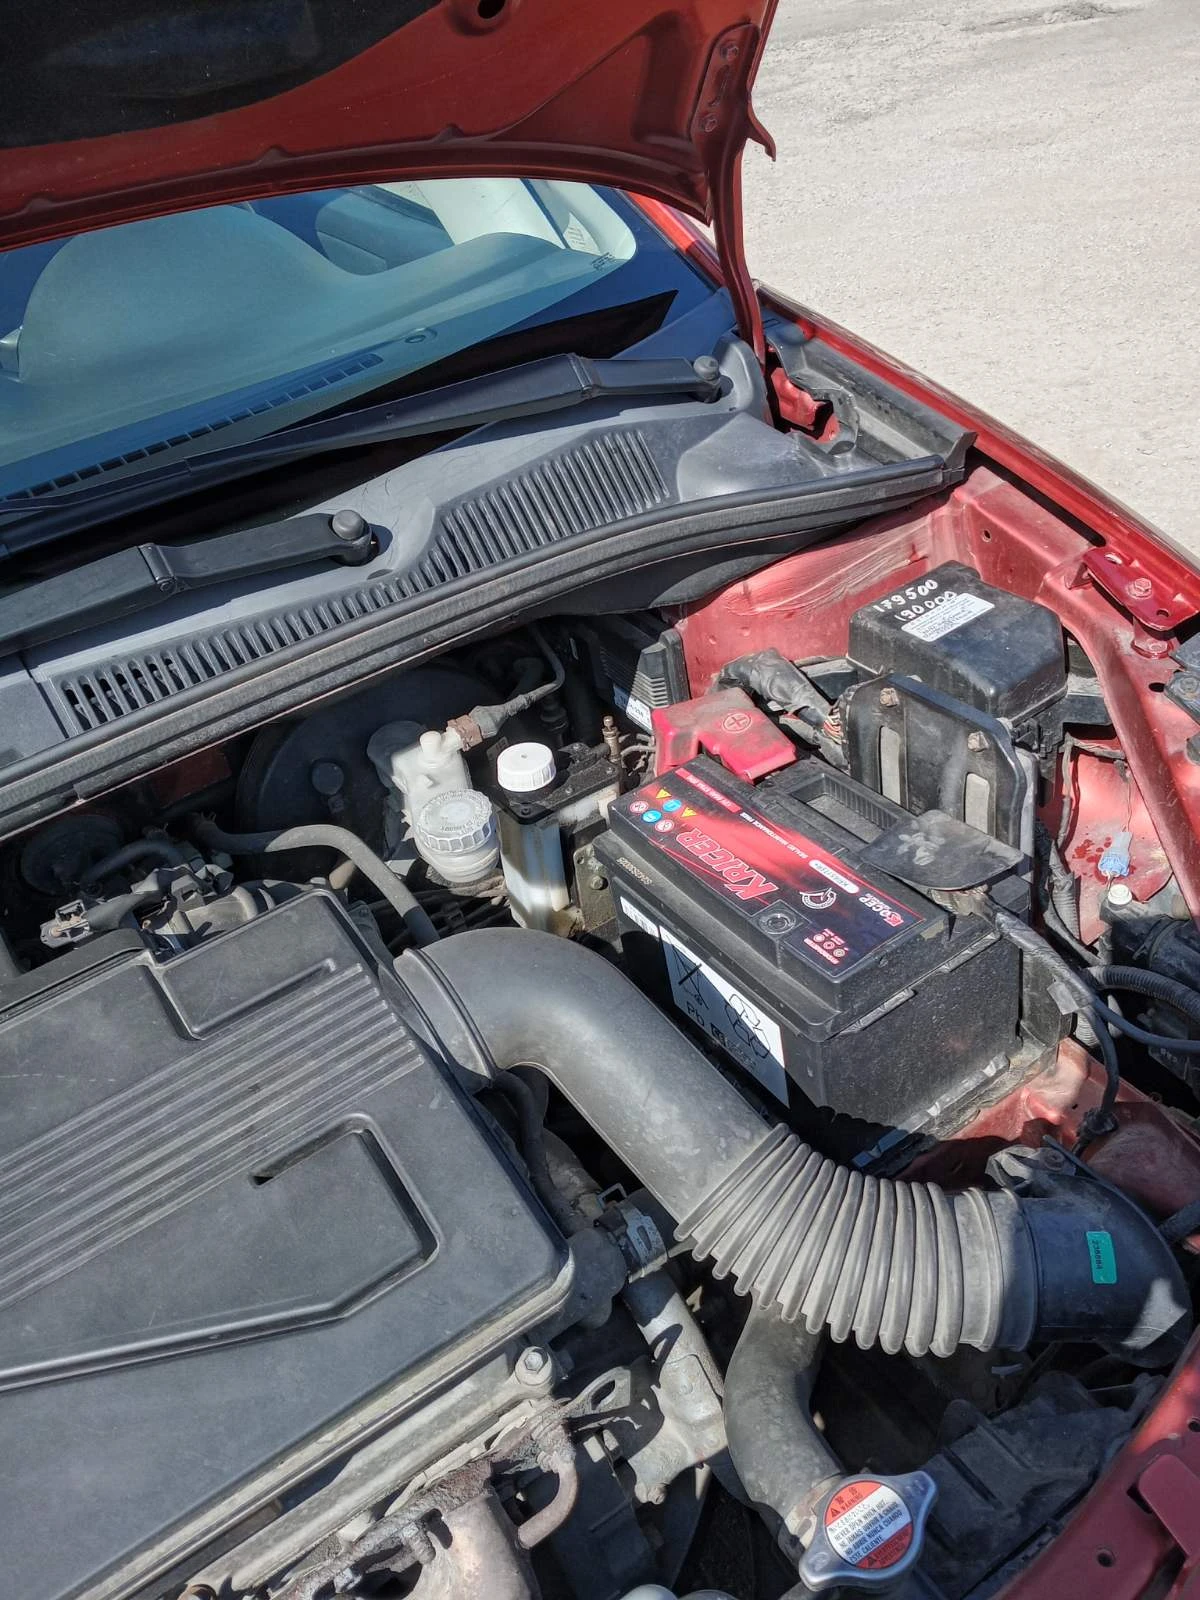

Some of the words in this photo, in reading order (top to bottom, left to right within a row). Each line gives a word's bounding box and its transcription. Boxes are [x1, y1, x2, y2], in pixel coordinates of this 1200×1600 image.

[872, 579, 938, 612] 179500
[894, 591, 957, 621] 190000
[676, 827, 780, 900] KRIGER
[840, 1492, 863, 1511] WARNING
[834, 1527, 850, 1541] NEVER
[849, 1517, 863, 1530] OPEN
[862, 1506, 876, 1519] WHEN
[844, 1546, 853, 1556] NO
[852, 1535, 867, 1550] ABRIR
[866, 1523, 883, 1539] NUNCA
[882, 1508, 902, 1526] CUANDO
[845, 1527, 863, 1543] JAMAIS
[861, 1534, 883, 1553] CALIENTE
